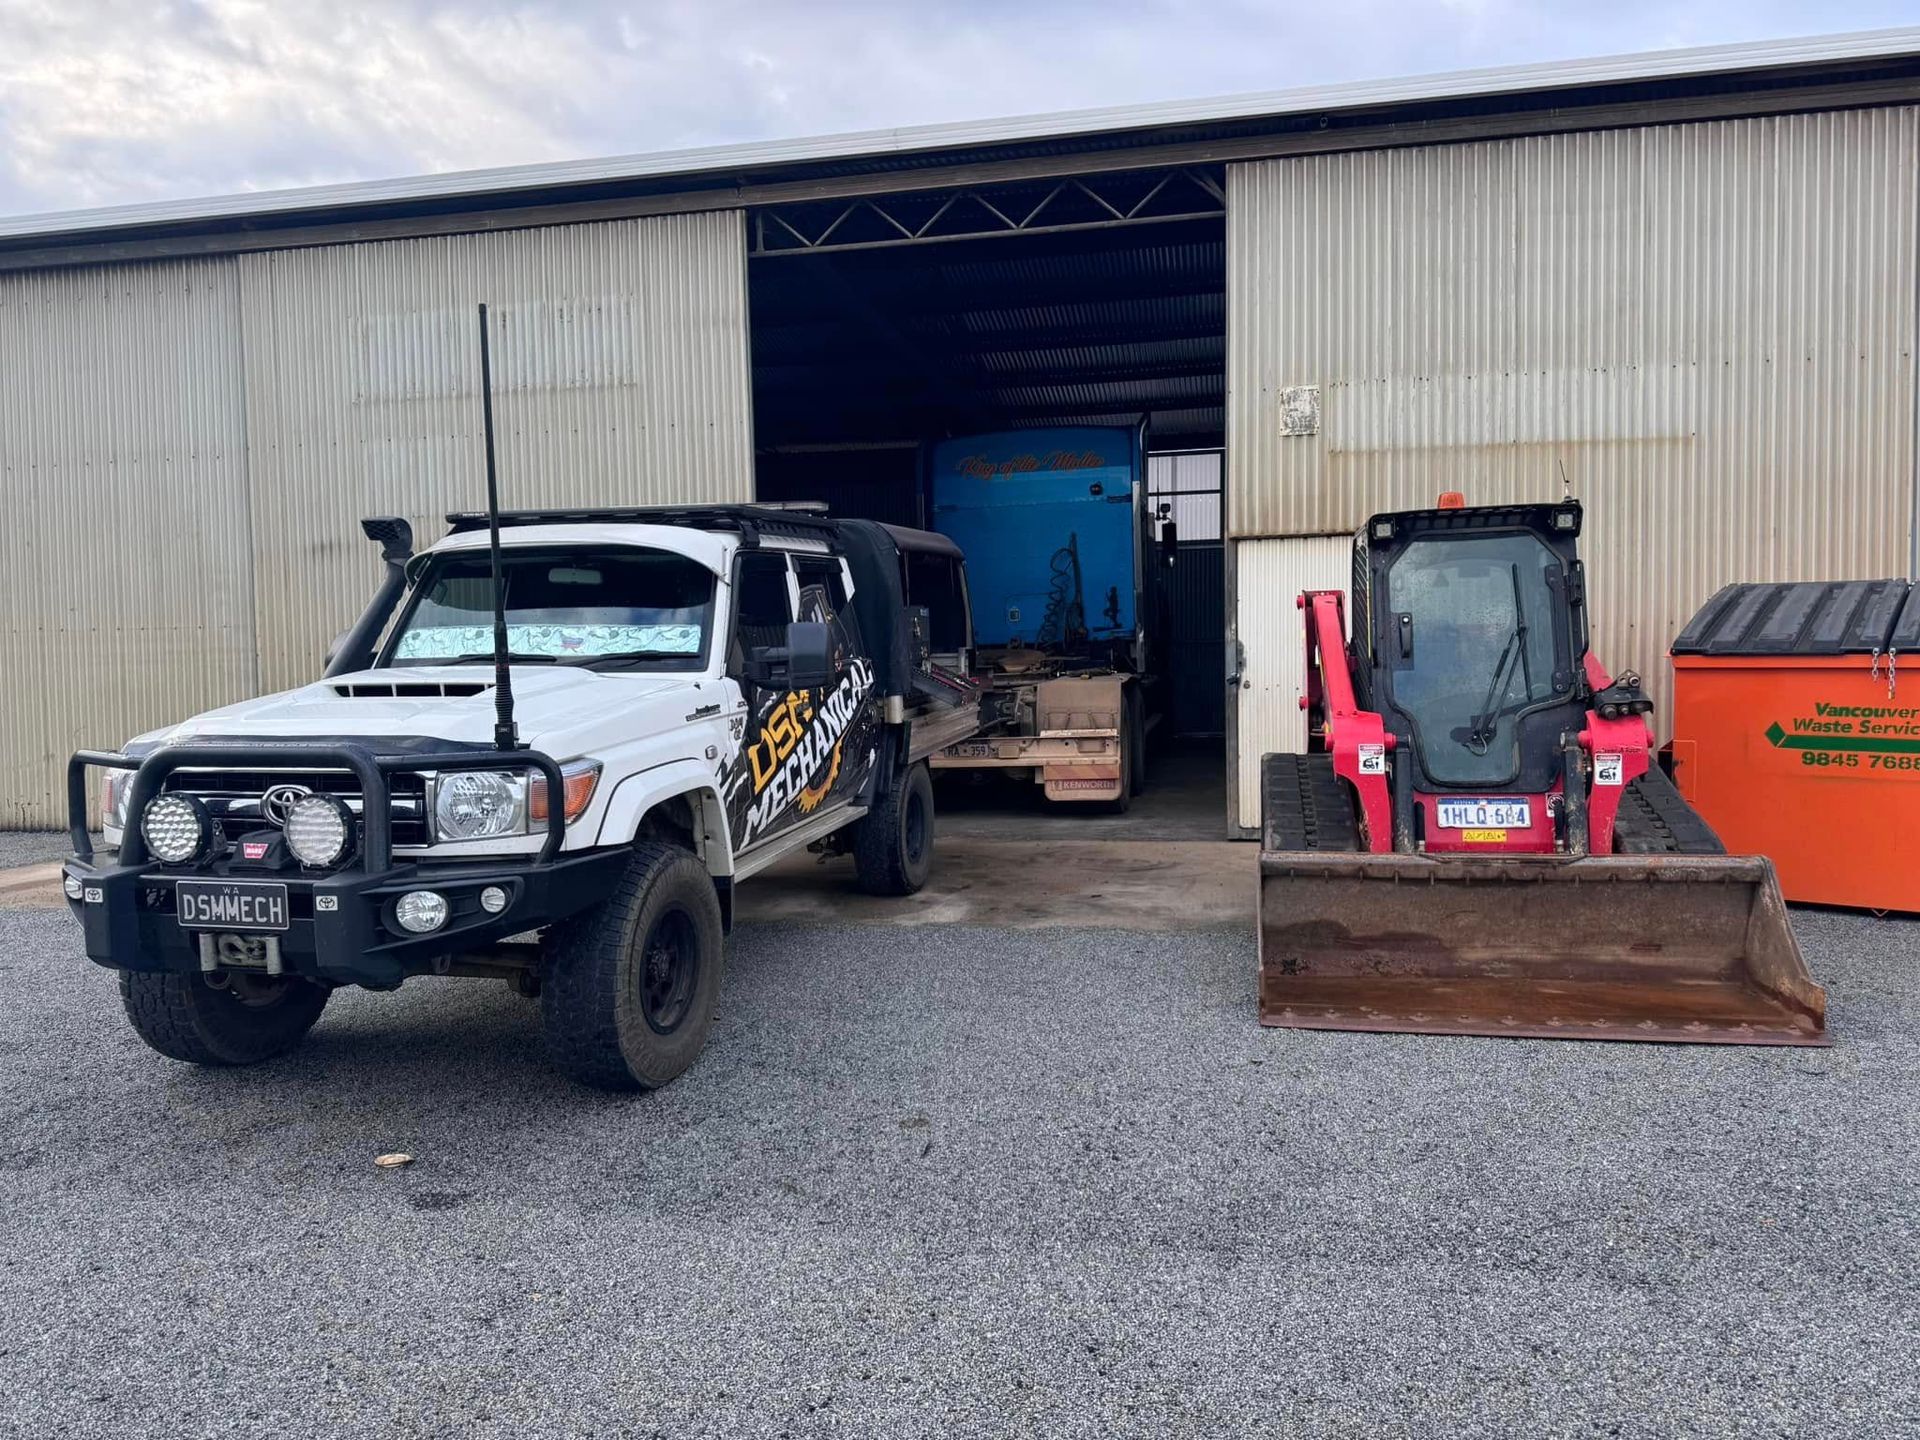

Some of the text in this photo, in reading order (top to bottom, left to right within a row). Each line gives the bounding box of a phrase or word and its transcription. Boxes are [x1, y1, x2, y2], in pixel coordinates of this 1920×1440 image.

[1814, 702, 1919, 718] Vancouver
[1793, 718, 1853, 733] Waste
[740, 659, 874, 850] MECHANICAL
[1802, 751, 1859, 767] 9845
[1063, 780, 1115, 790] KENWORTH
[182, 894, 282, 923] DSMMECH
